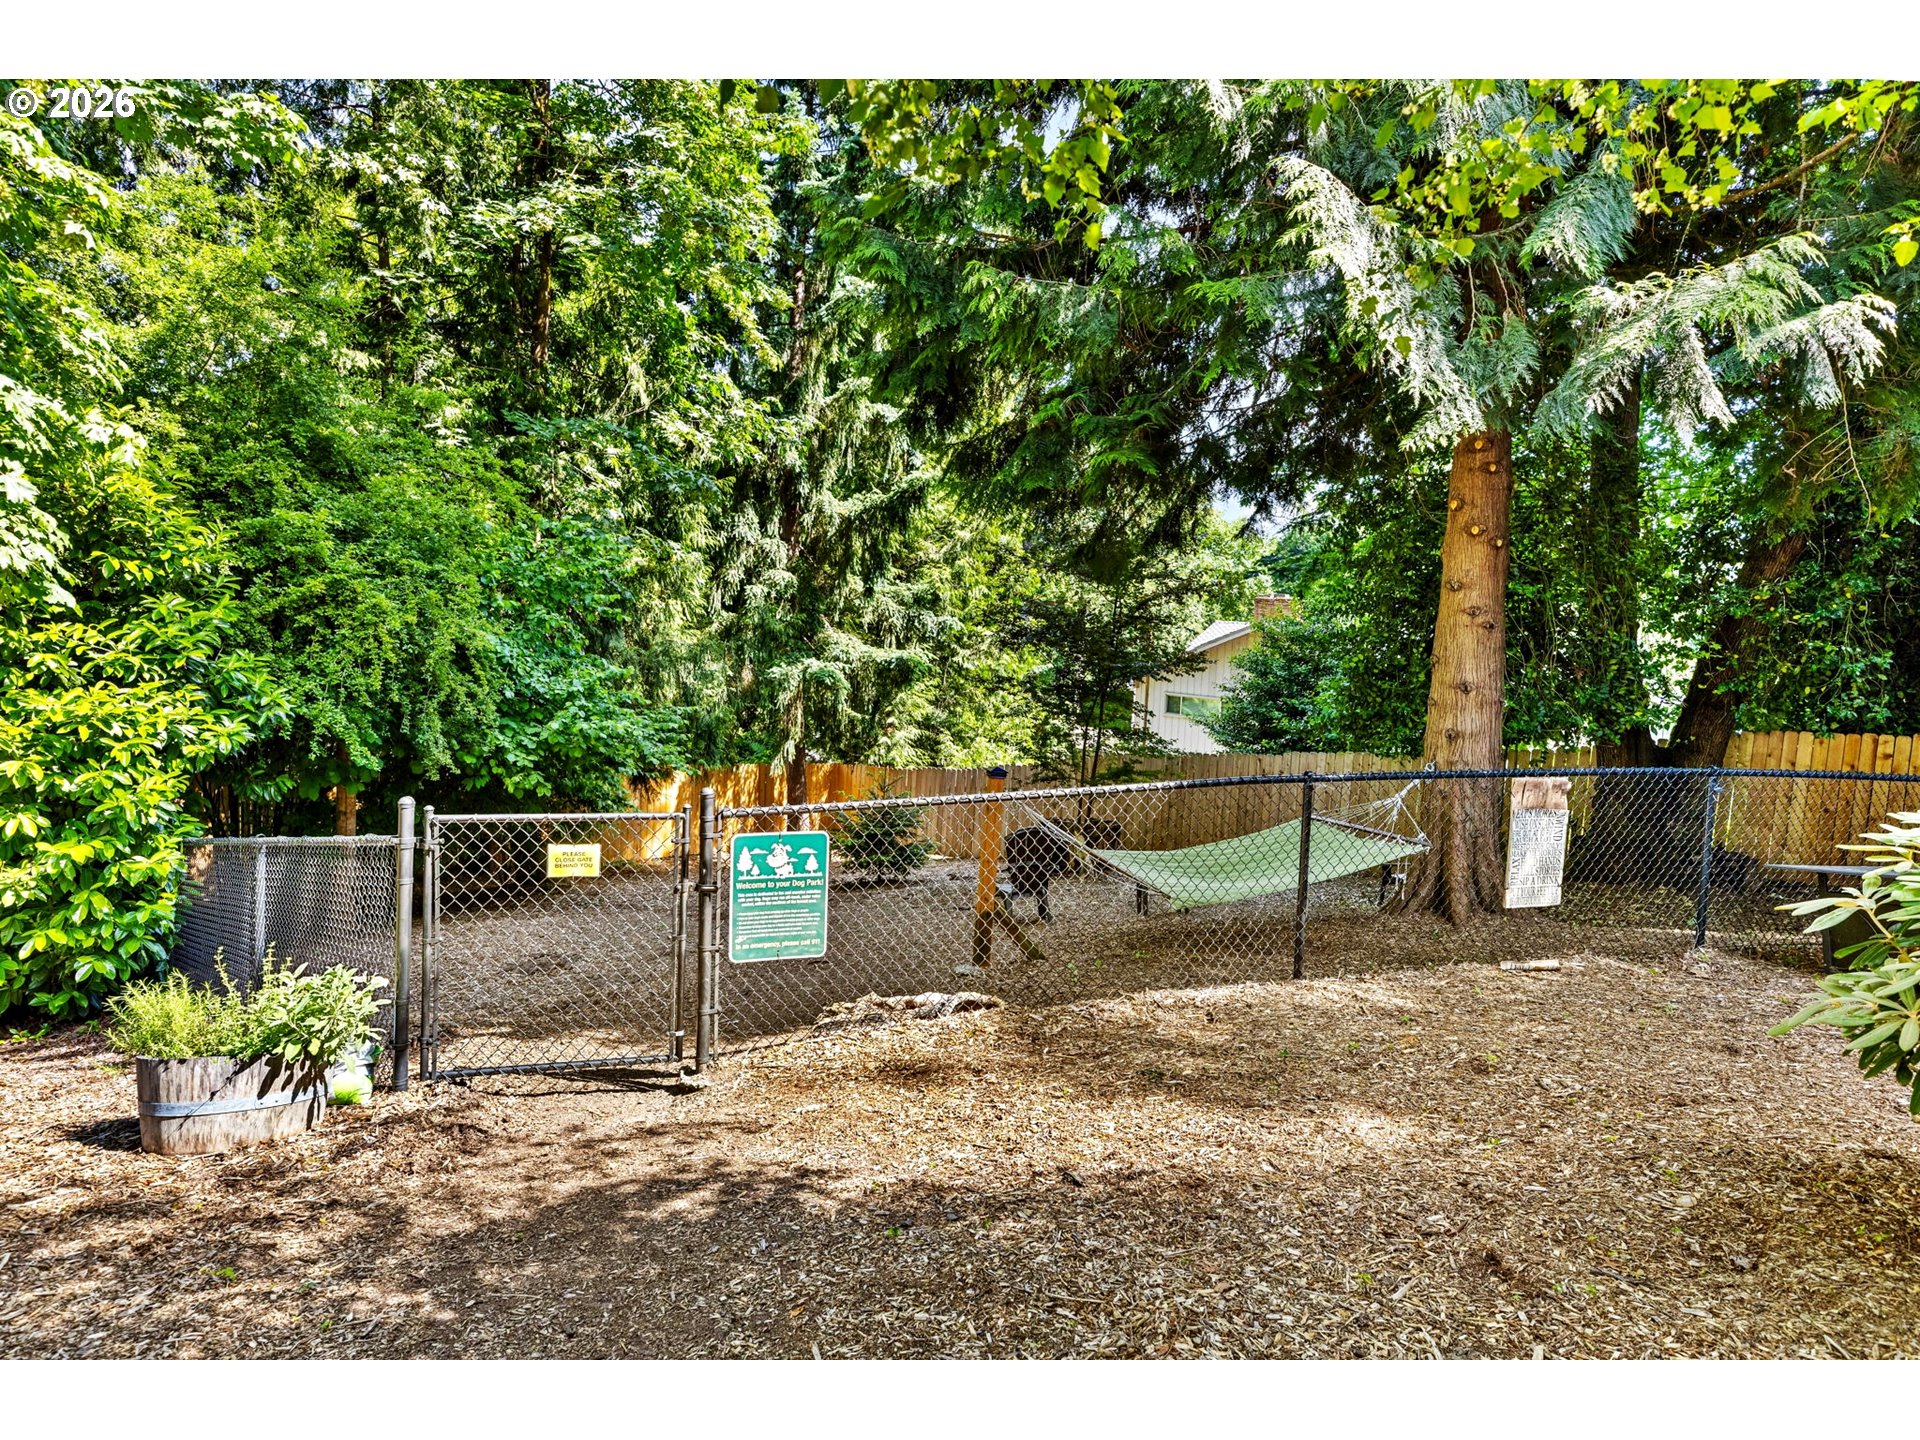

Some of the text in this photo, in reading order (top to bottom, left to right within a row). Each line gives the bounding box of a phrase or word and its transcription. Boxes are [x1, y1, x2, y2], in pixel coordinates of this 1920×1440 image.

[1539, 856, 1561, 866] HANDS
[1535, 865, 1560, 876] STORIES
[736, 882, 766, 890] Welcome
[792, 880, 805, 888] Dog
[1537, 875, 1560, 886] DRINK
